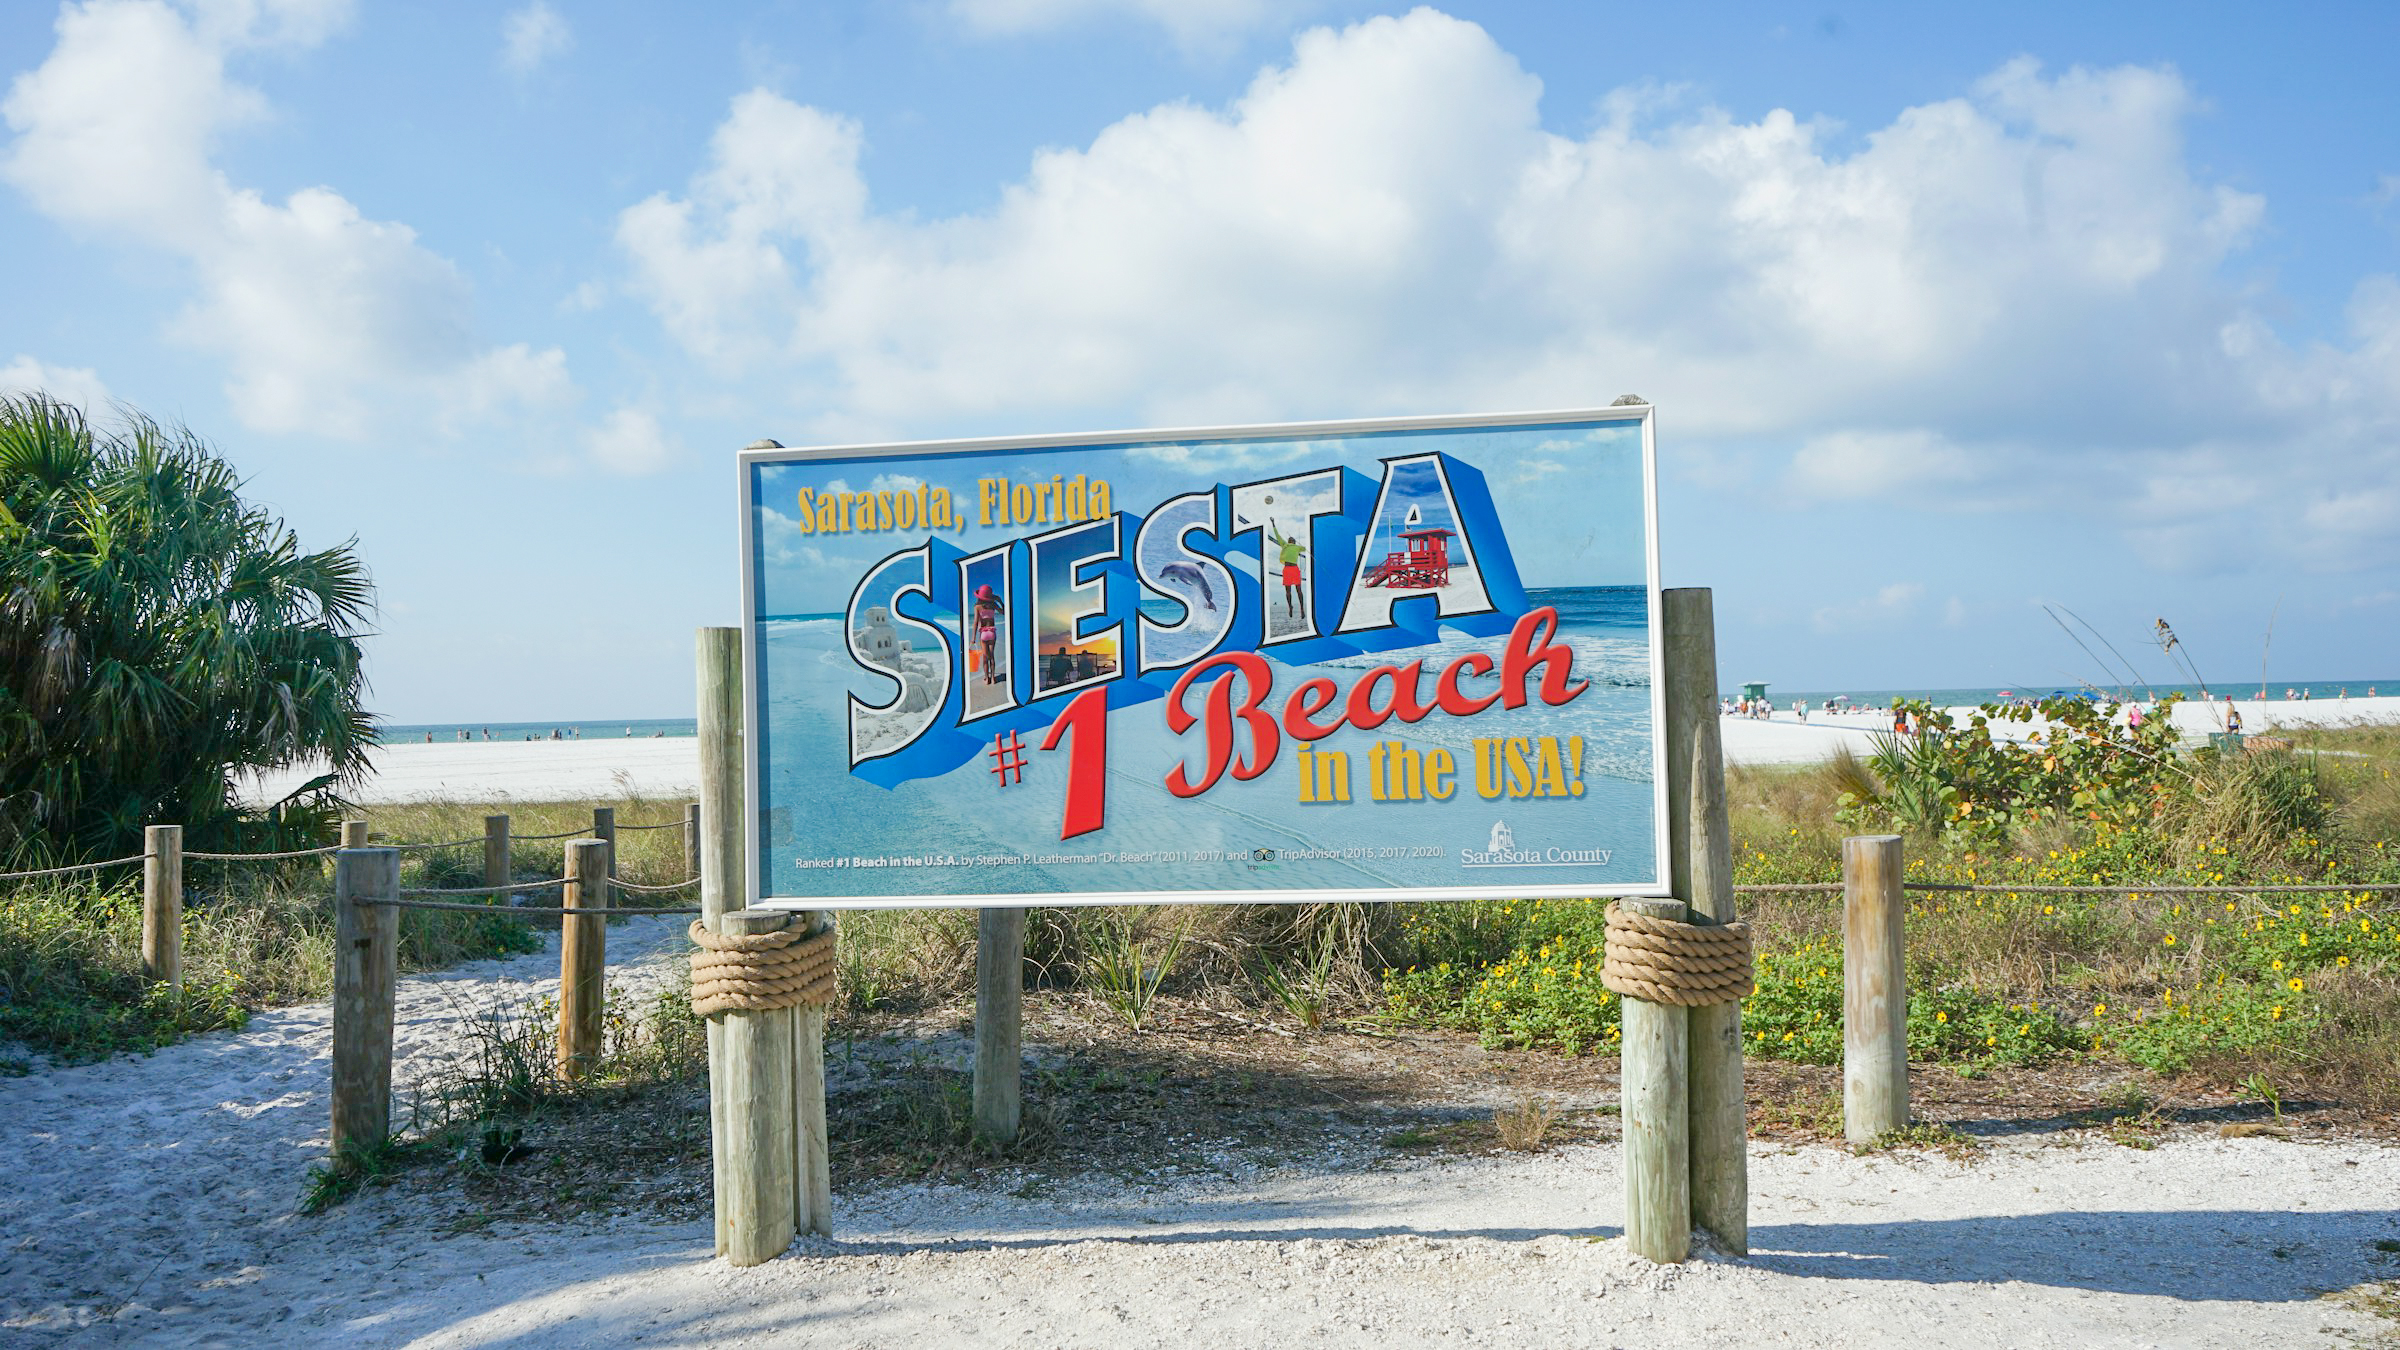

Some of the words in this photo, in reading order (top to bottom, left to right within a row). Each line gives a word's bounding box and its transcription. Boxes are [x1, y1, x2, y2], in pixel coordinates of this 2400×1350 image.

[798, 483, 964, 534] Sarasota,
[978, 474, 1111, 525] Florida
[845, 451, 1497, 768] SIESTA
[1164, 606, 1590, 798] Beach
[1298, 742, 1351, 802] in
[1368, 741, 1455, 800] the
[1472, 736, 1585, 798] USA!
[795, 857, 834, 869] Ranked
[836, 857, 850, 868] #1
[852, 856, 887, 868] Beach
[889, 856, 901, 867] in
[902, 856, 923, 867] the
[924, 855, 960, 867] U.S.A.
[961, 855, 975, 868] by
[976, 854, 1021, 868] Stephen
[1023, 854, 1032, 865] P.
[1033, 853, 1097, 865] Leatherman
[1099, 852, 1118, 863] "Dr.
[1120, 851, 1157, 863] Beach"
[1158, 851, 1192, 863] (2011,
[1194, 850, 1224, 863] 2017)
[1227, 849, 1248, 861] and
[1279, 848, 1341, 861] TripAdvisor
[1343, 848, 1377, 860] (2015,
[1379, 847, 1409, 860] 2017,
[1412, 846, 1447, 859] 2020).
[1461, 848, 1541, 864] Sarasota
[1546, 847, 1612, 865] County
